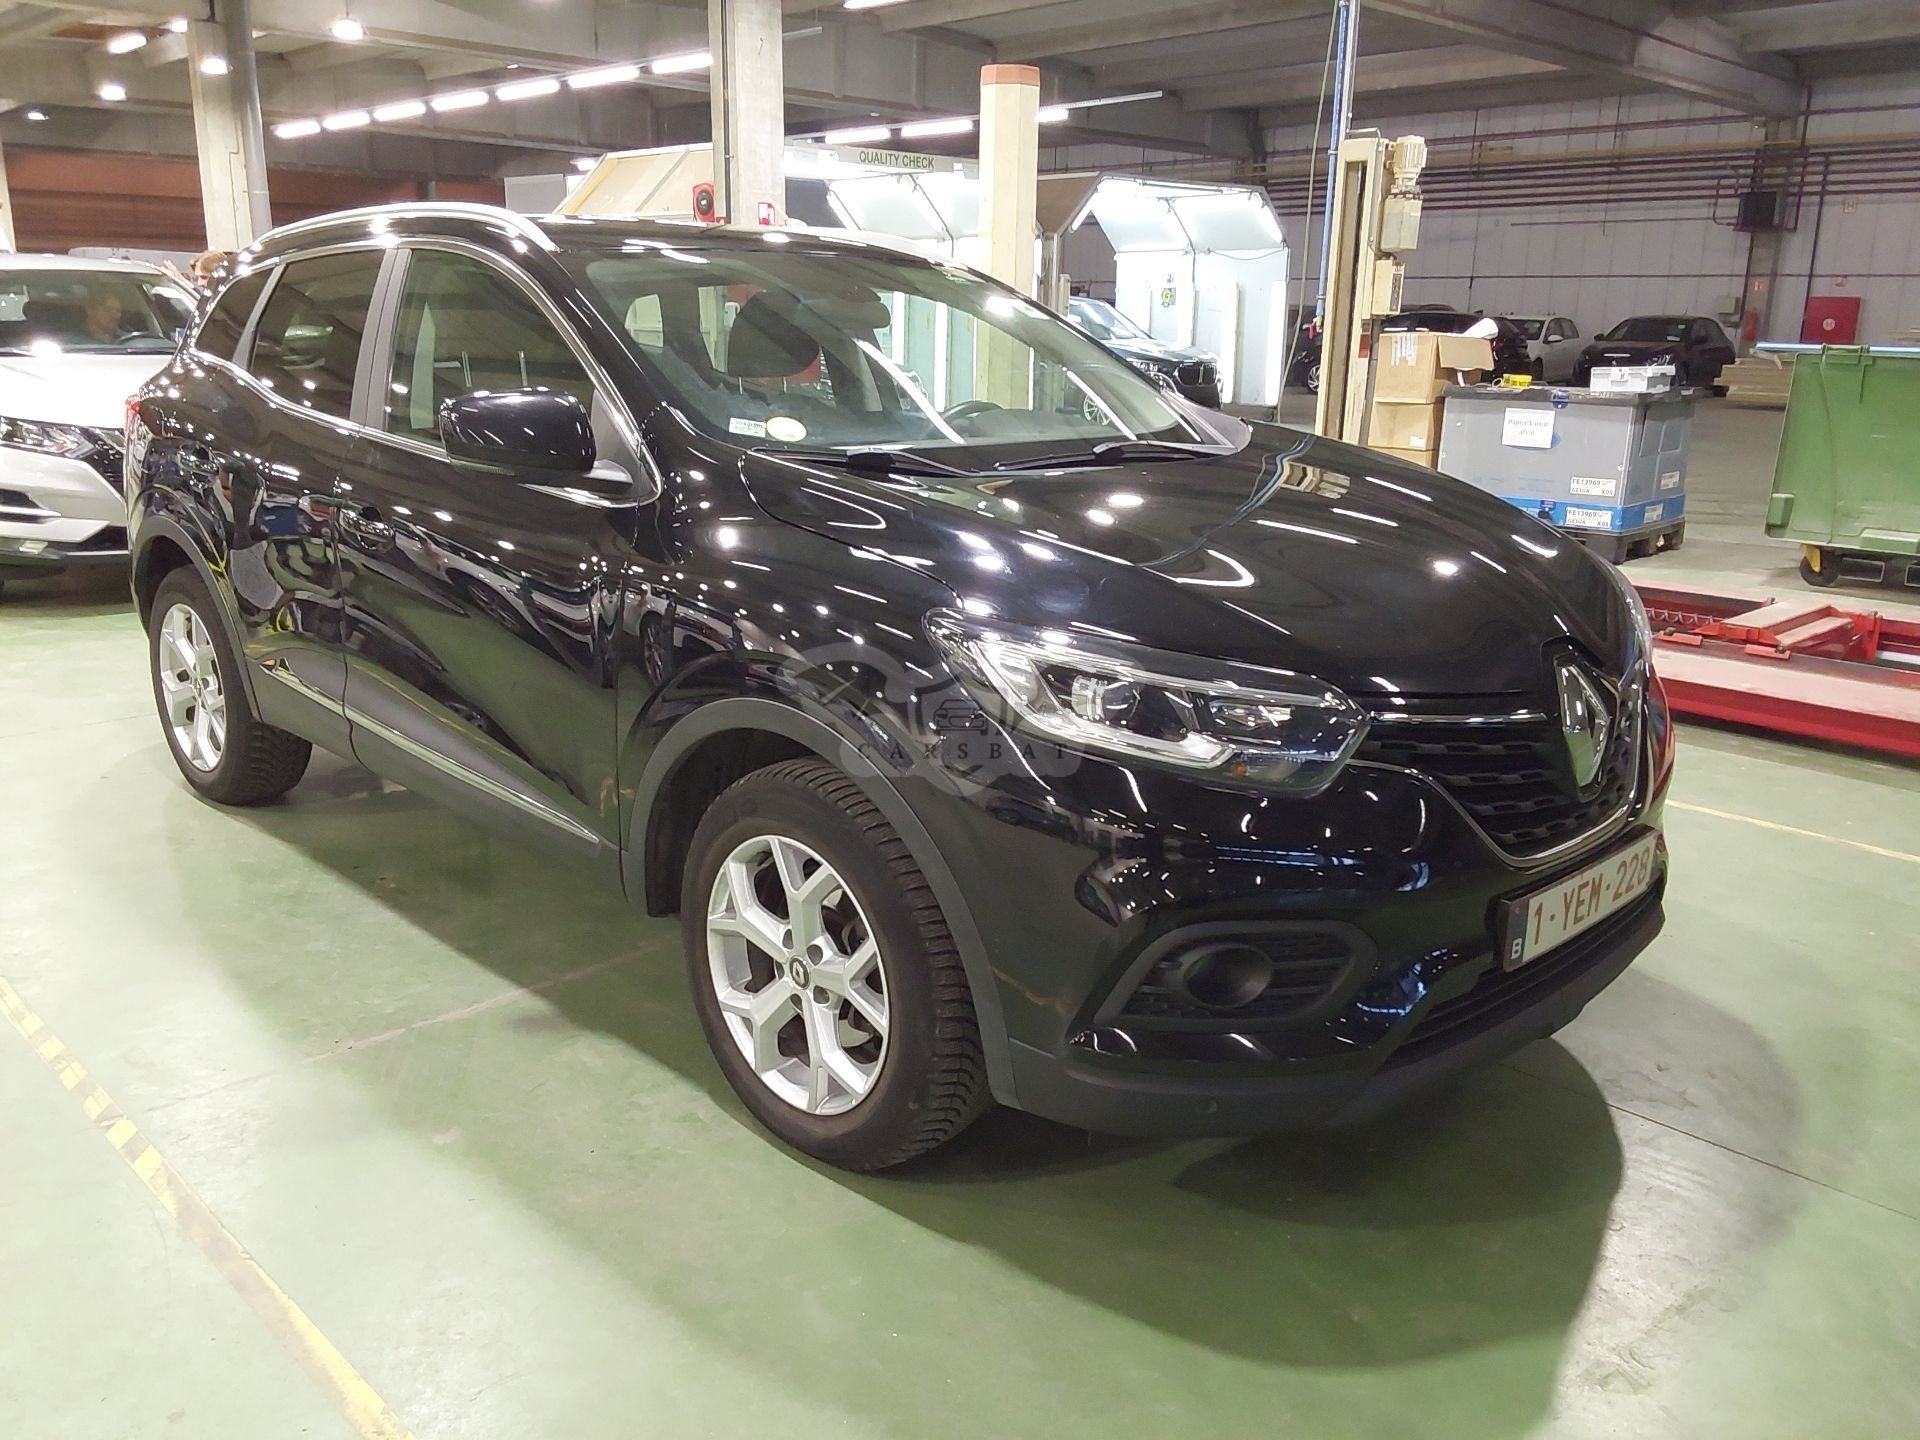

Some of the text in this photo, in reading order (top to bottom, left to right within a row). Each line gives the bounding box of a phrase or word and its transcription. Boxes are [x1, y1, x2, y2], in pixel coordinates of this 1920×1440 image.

[859, 150, 935, 169] QUALITY CHECK
[1572, 478, 1601, 486] FE13969
[1568, 509, 1597, 518] FE13969
[1511, 937, 1523, 960] B
